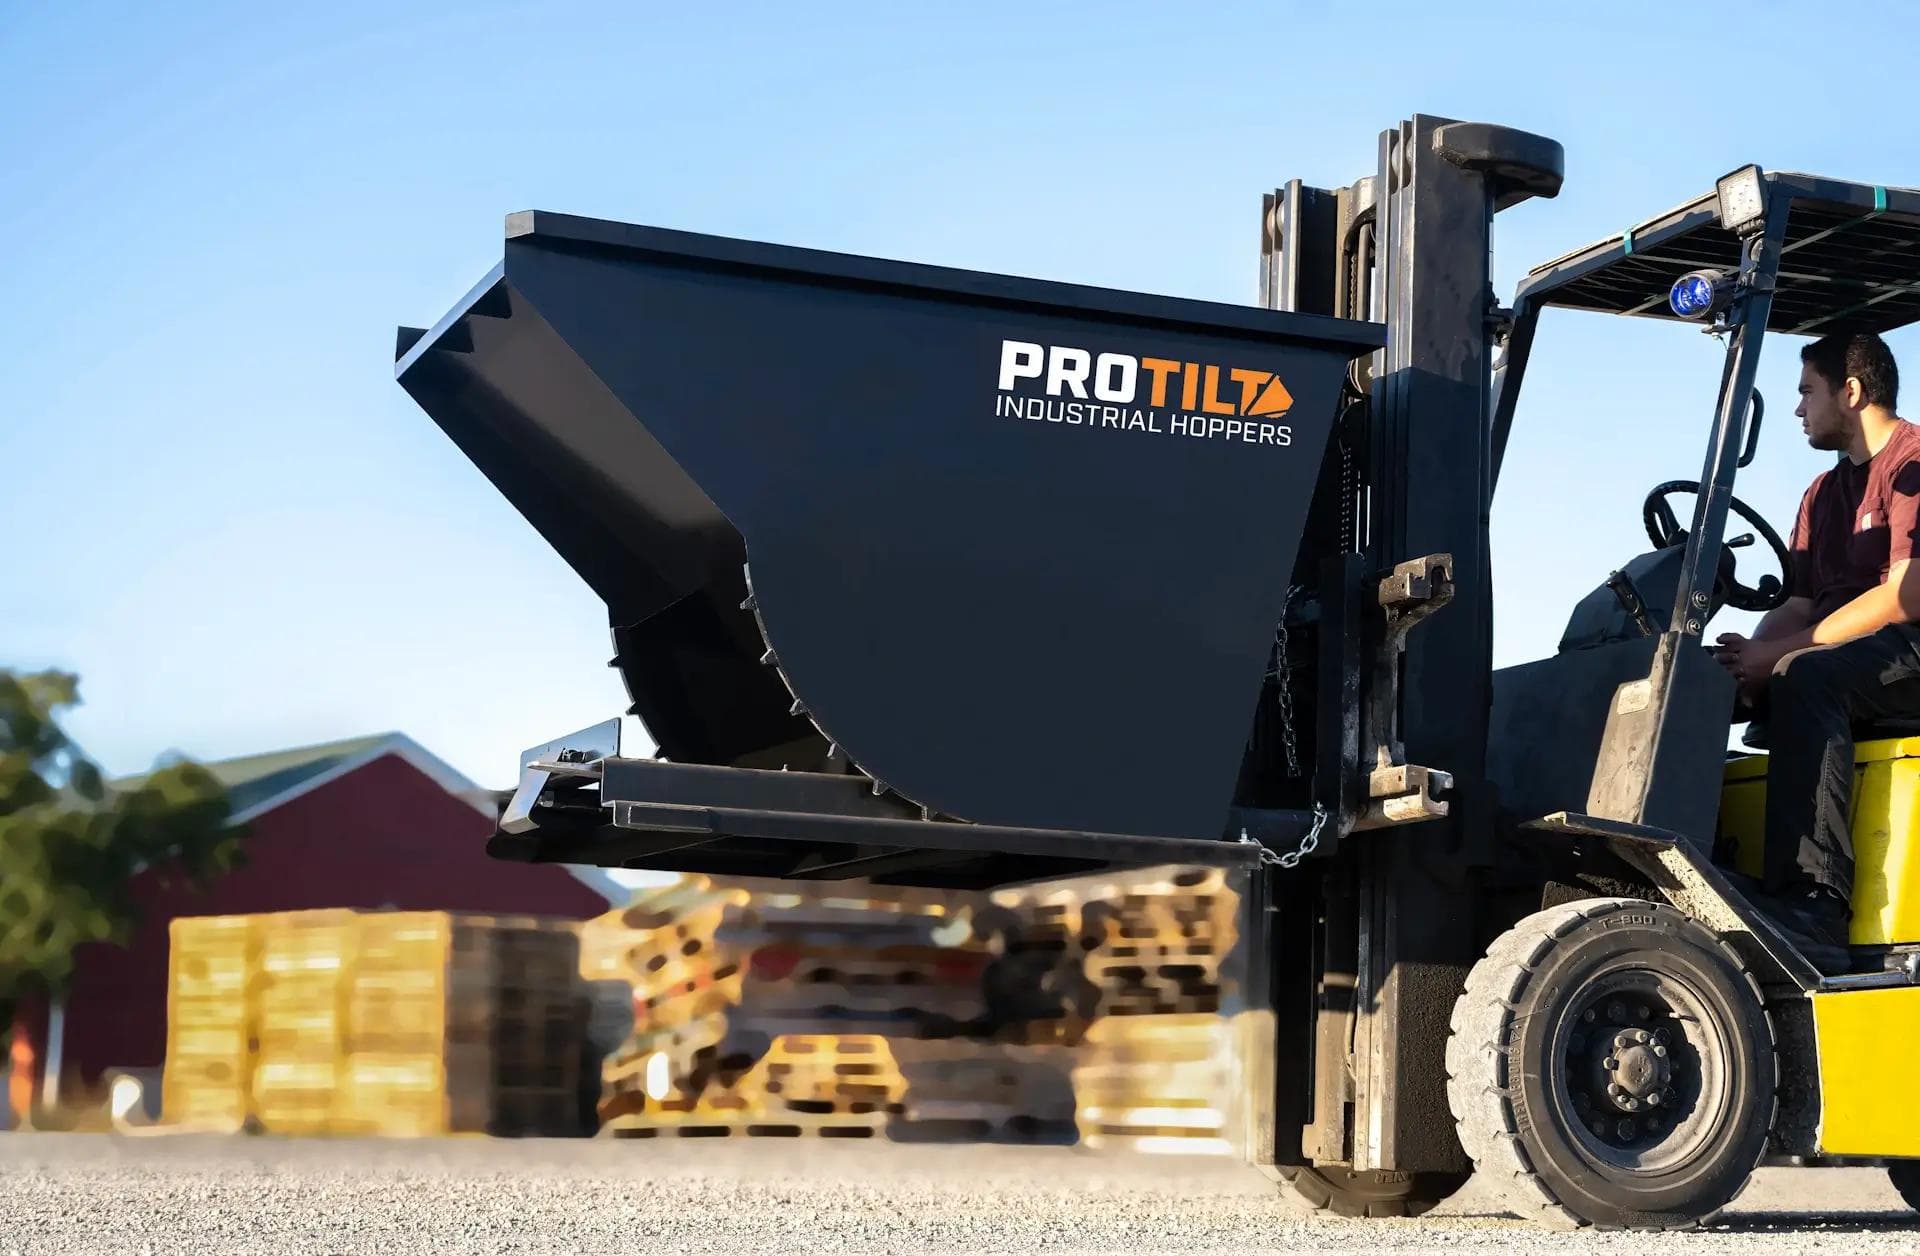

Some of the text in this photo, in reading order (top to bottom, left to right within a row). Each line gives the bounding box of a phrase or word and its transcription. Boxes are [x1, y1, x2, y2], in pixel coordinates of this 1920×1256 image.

[998, 339, 1275, 416] PROTILT
[995, 394, 1292, 446] INDUSTRIAL HOPPERS
